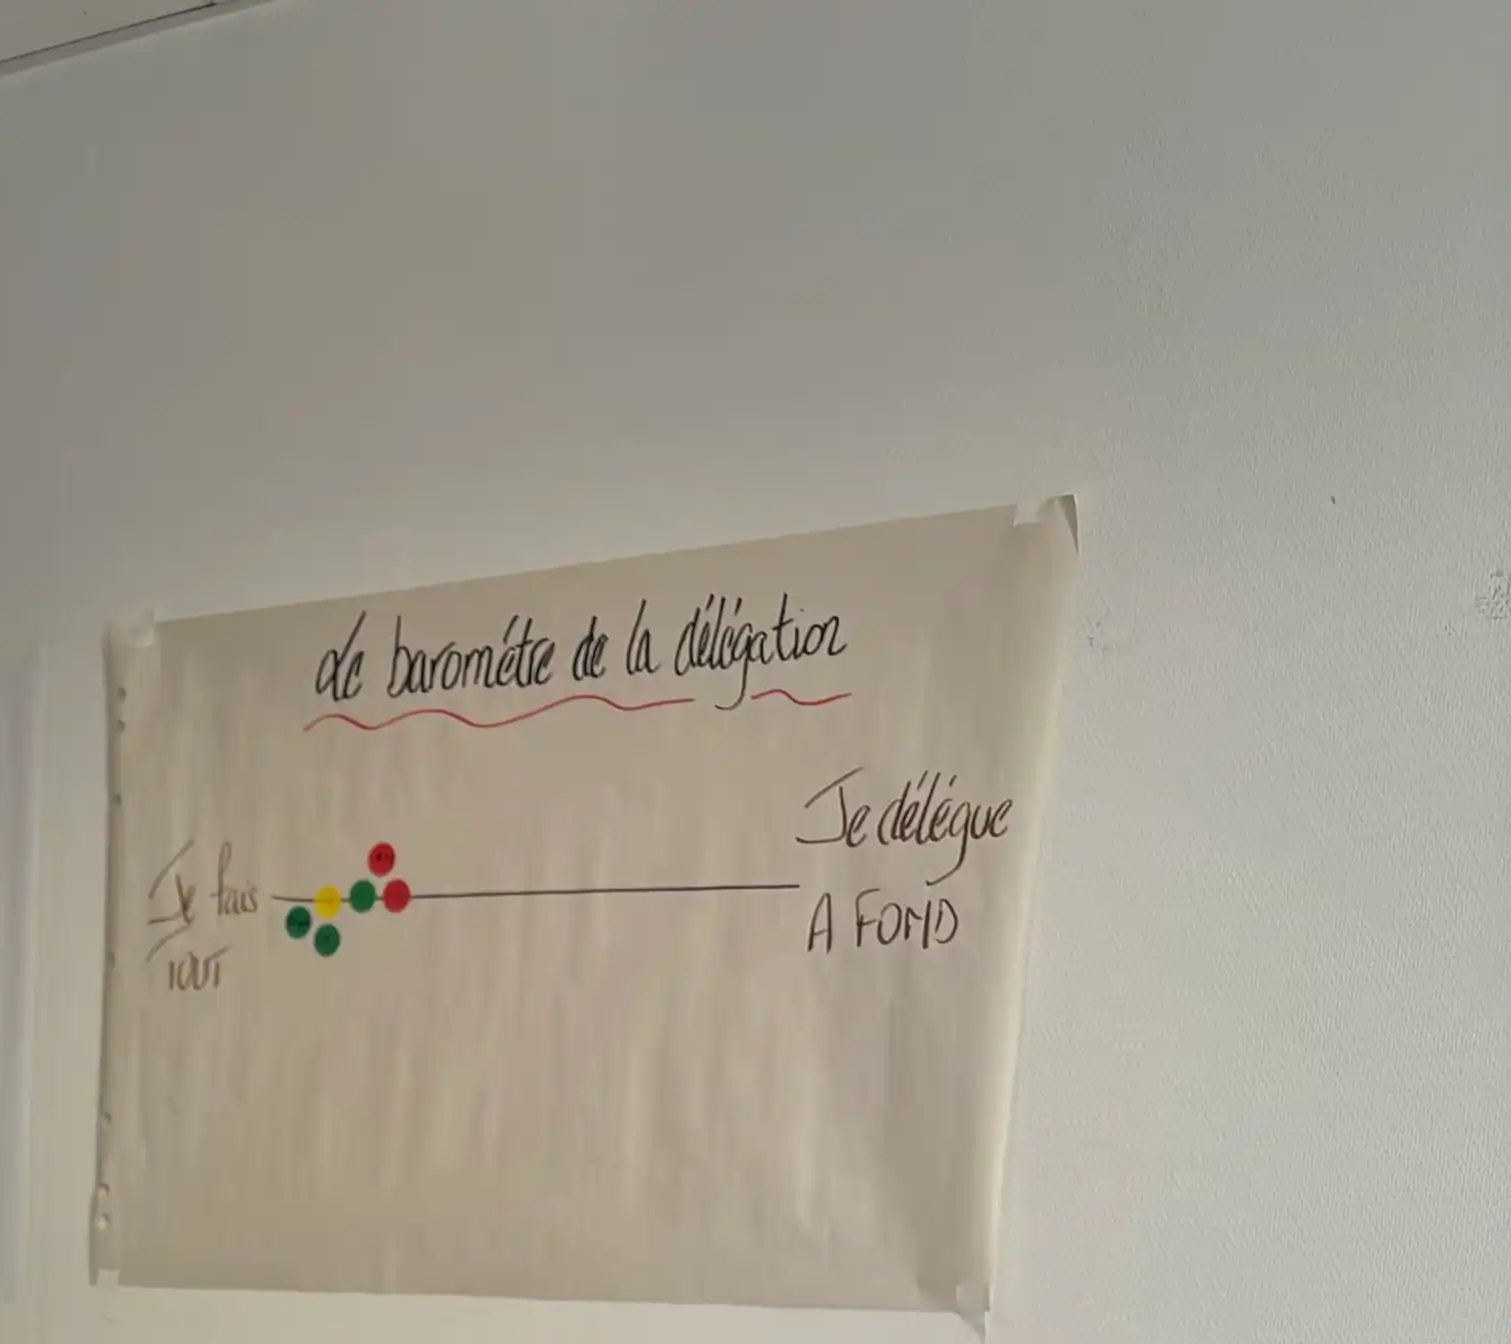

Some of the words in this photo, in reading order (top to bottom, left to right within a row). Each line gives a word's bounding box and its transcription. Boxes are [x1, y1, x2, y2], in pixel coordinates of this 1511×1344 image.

[571, 614, 610, 681] de
[626, 598, 661, 677] la
[795, 765, 873, 848] Je
[807, 892, 834, 954] A
[854, 888, 960, 950] FOND
